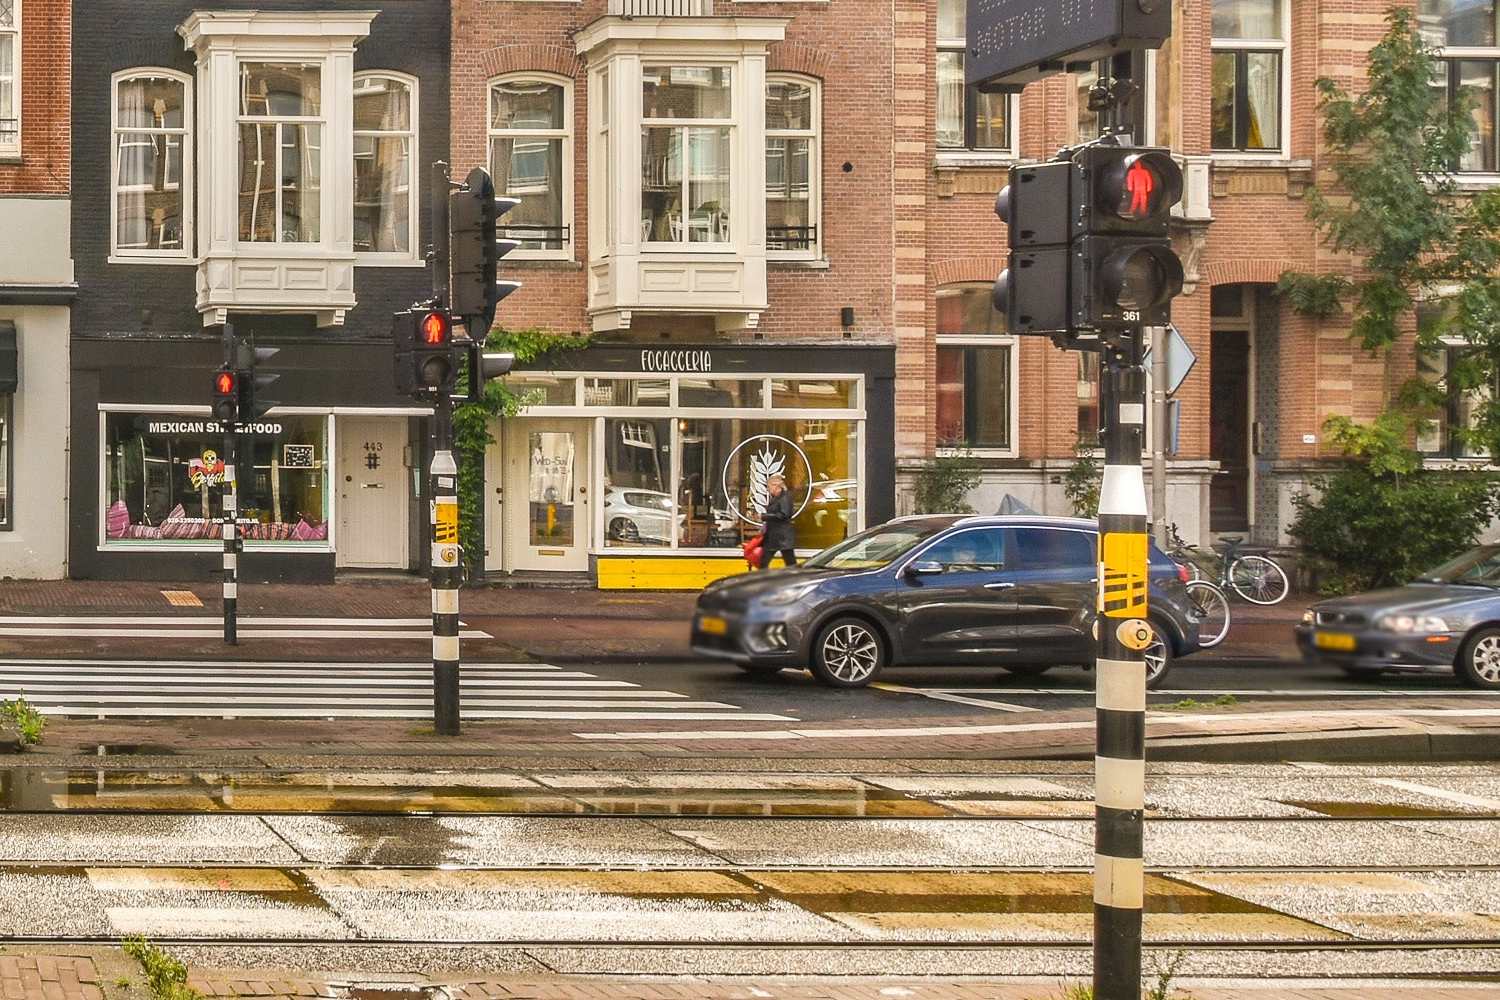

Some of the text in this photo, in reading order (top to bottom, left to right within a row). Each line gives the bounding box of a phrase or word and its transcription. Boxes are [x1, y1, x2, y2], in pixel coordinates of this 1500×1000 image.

[975, 6, 1047, 59] MOTOR
[1122, 311, 1140, 321] 361
[641, 349, 712, 372] FOCACCERIA
[149, 422, 283, 434] MEXICAN STETFOOD
